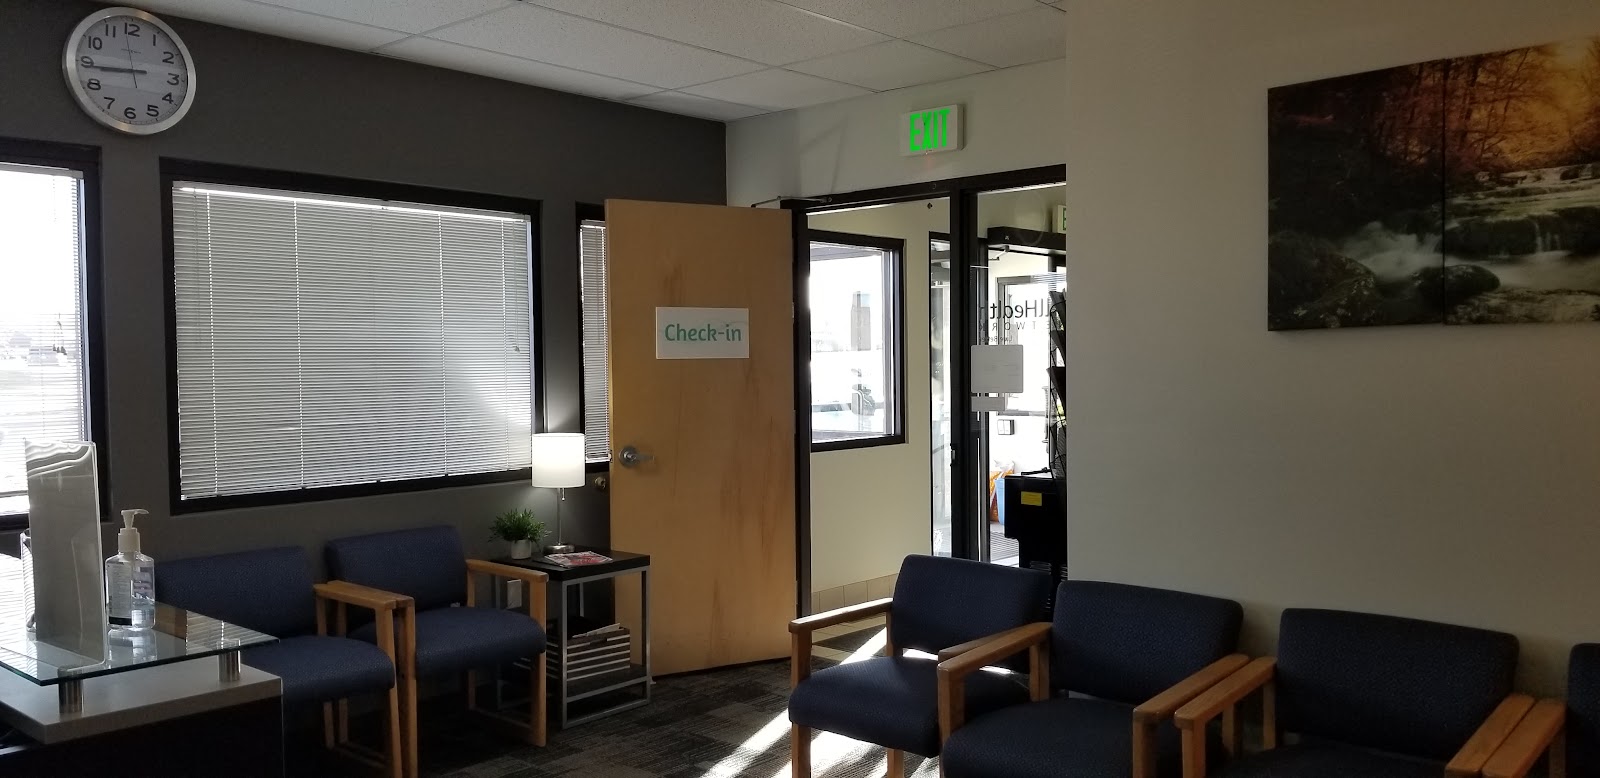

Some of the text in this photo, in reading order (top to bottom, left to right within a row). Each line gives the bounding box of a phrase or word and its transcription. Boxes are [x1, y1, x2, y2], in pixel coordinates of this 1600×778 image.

[105, 24, 116, 38] 11
[124, 22, 141, 37] 12
[88, 35, 103, 50] 10
[152, 34, 156, 46] 1
[80, 56, 94, 68] 9
[162, 51, 174, 64] 2
[87, 78, 101, 91] 8
[167, 72, 180, 86] 3
[103, 96, 115, 109] 7
[162, 92, 174, 104] 4
[124, 107, 136, 120] 6
[146, 104, 159, 117] 5
[909, 107, 951, 152] EXIT
[664, 323, 742, 342] Check-in
